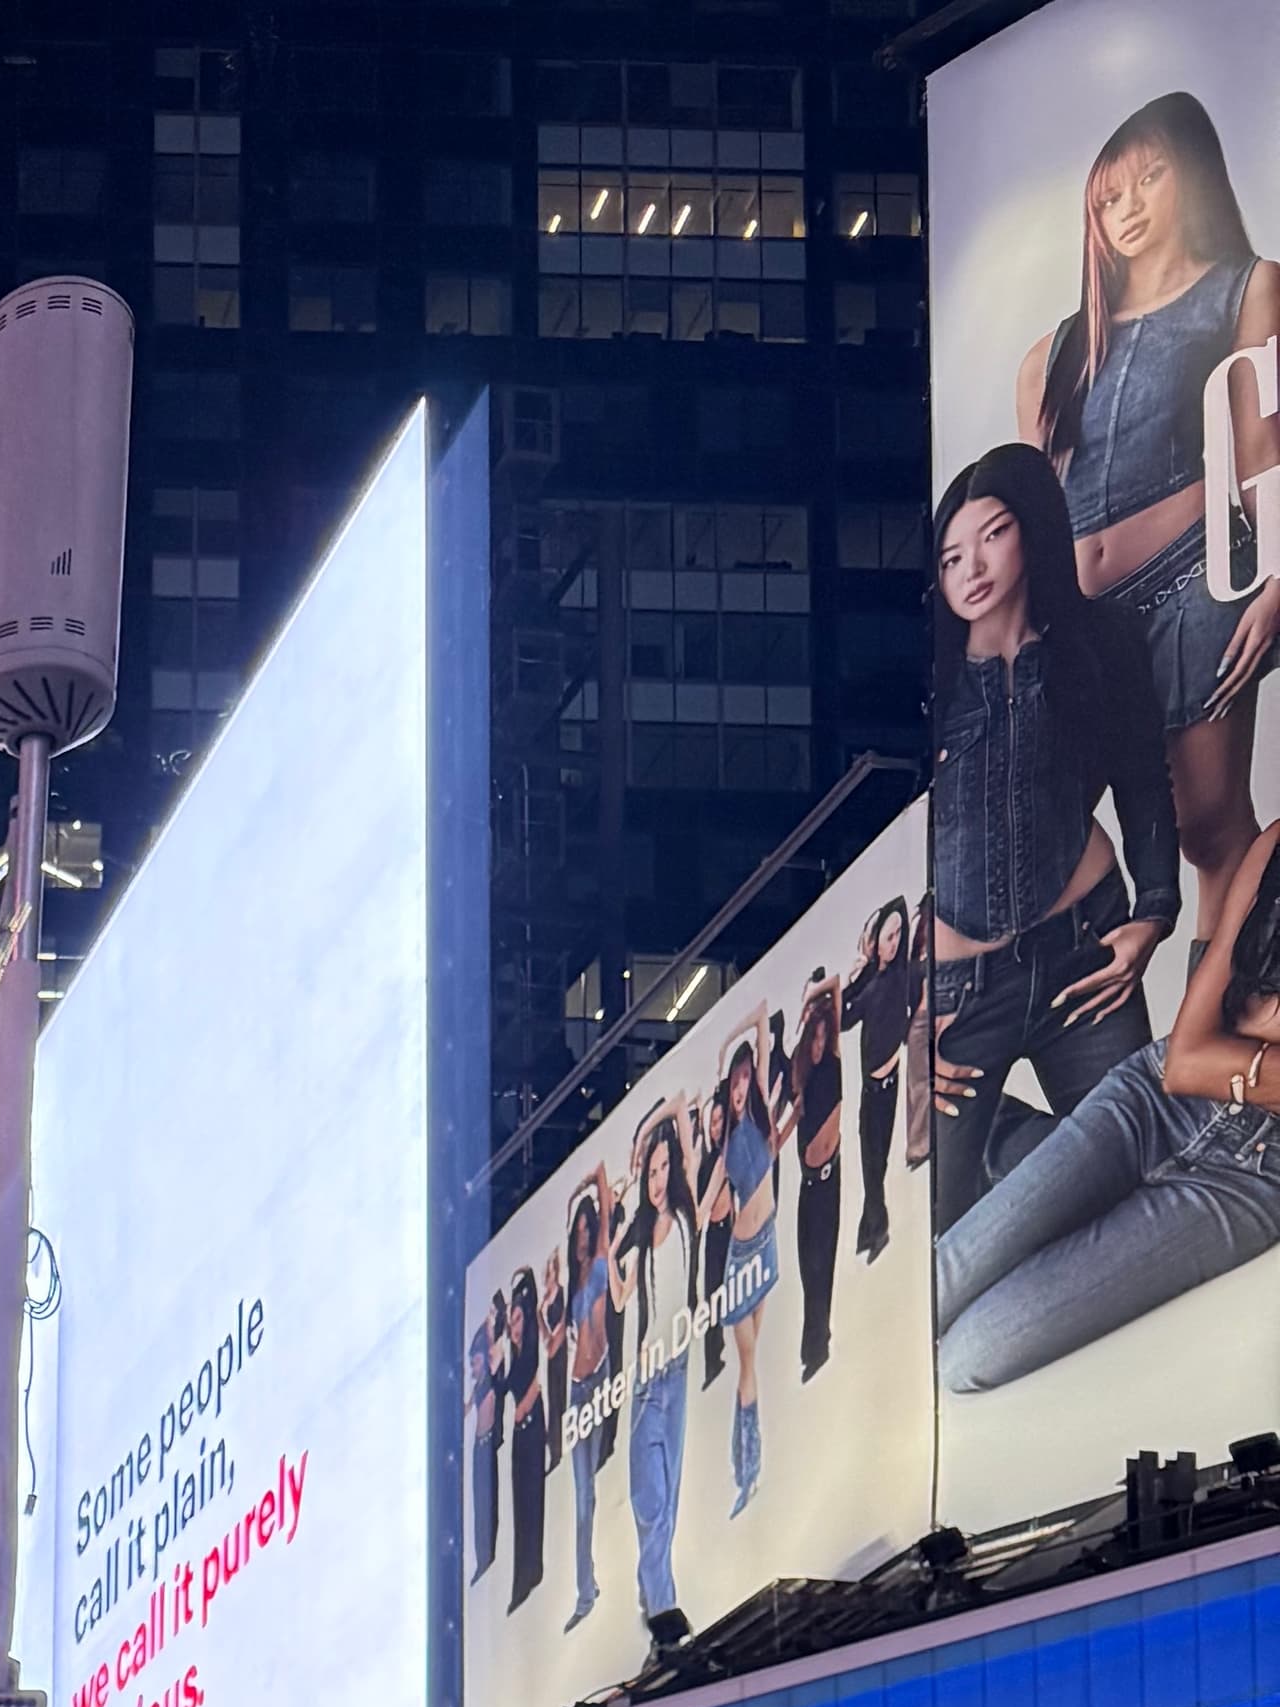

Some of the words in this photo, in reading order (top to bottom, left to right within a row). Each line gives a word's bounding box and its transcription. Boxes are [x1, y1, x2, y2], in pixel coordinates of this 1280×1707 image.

[76, 1438, 152, 1558] Some
[158, 1297, 265, 1484] people
[562, 1362, 633, 1453] Better
[641, 1342, 665, 1384] in
[672, 1254, 771, 1360] Denim.
[74, 1545, 121, 1646] call
[124, 1515, 147, 1583] it
[152, 1437, 236, 1585] plain,
[115, 1581, 166, 1695] call
[172, 1561, 194, 1638] it
[201, 1448, 310, 1629] purely
